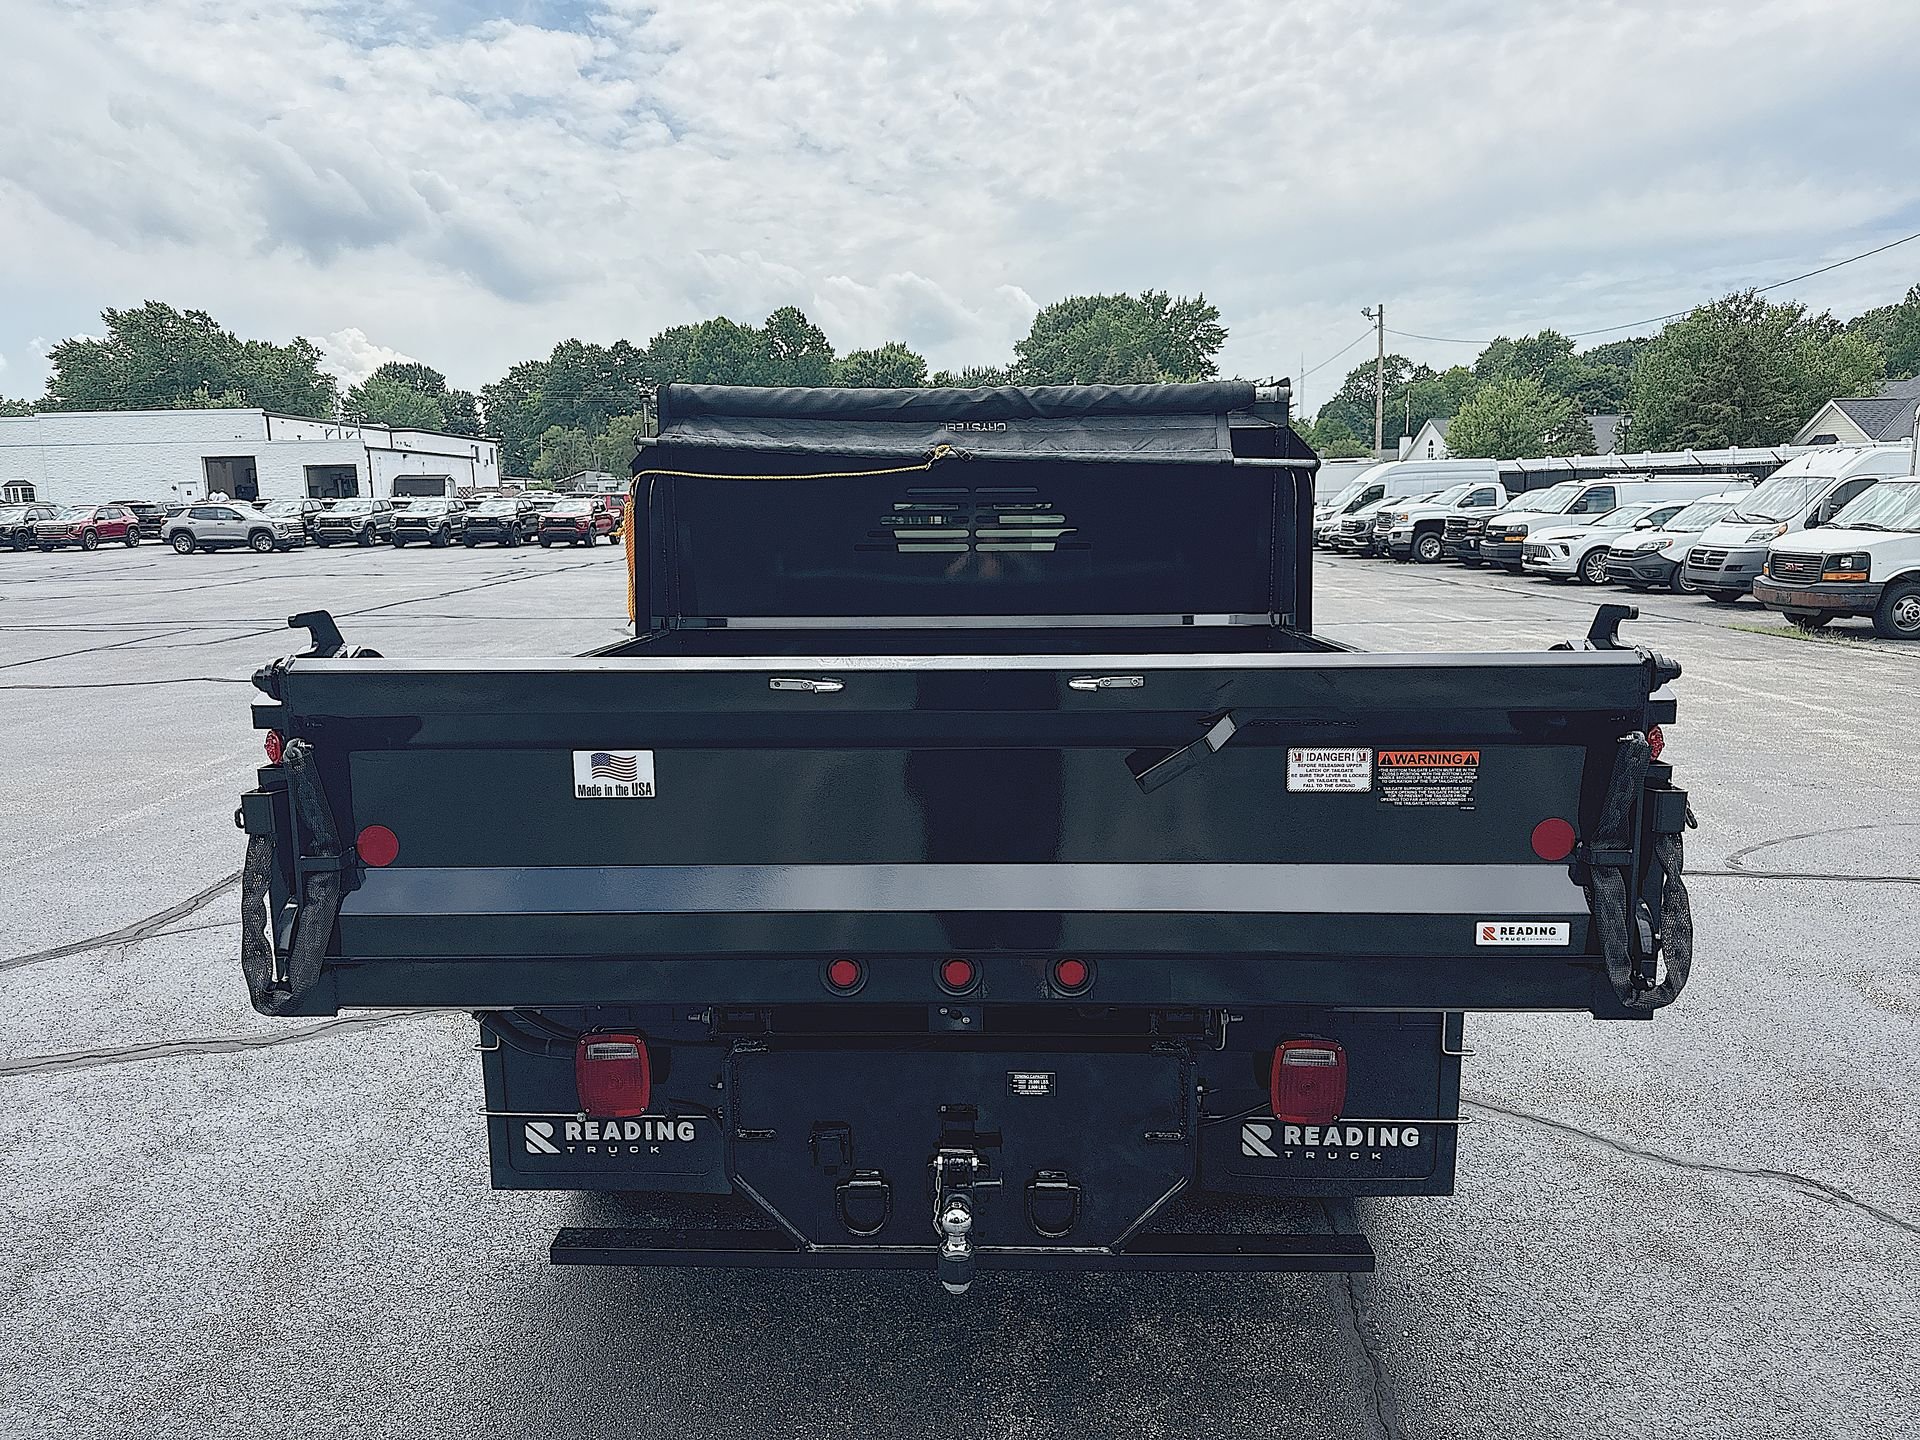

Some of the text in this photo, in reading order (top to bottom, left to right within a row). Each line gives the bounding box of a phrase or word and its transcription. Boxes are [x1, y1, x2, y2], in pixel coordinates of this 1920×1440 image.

[1306, 752, 1355, 762] !DANGER!
[1395, 754, 1462, 764] WARNING
[577, 782, 652, 797] Made in the USA
[1500, 926, 1557, 936] READING
[565, 1121, 695, 1142] READING
[1284, 1125, 1420, 1147] READING
[566, 1146, 660, 1154] TRUCK
[1284, 1151, 1382, 1160] TRUCK
